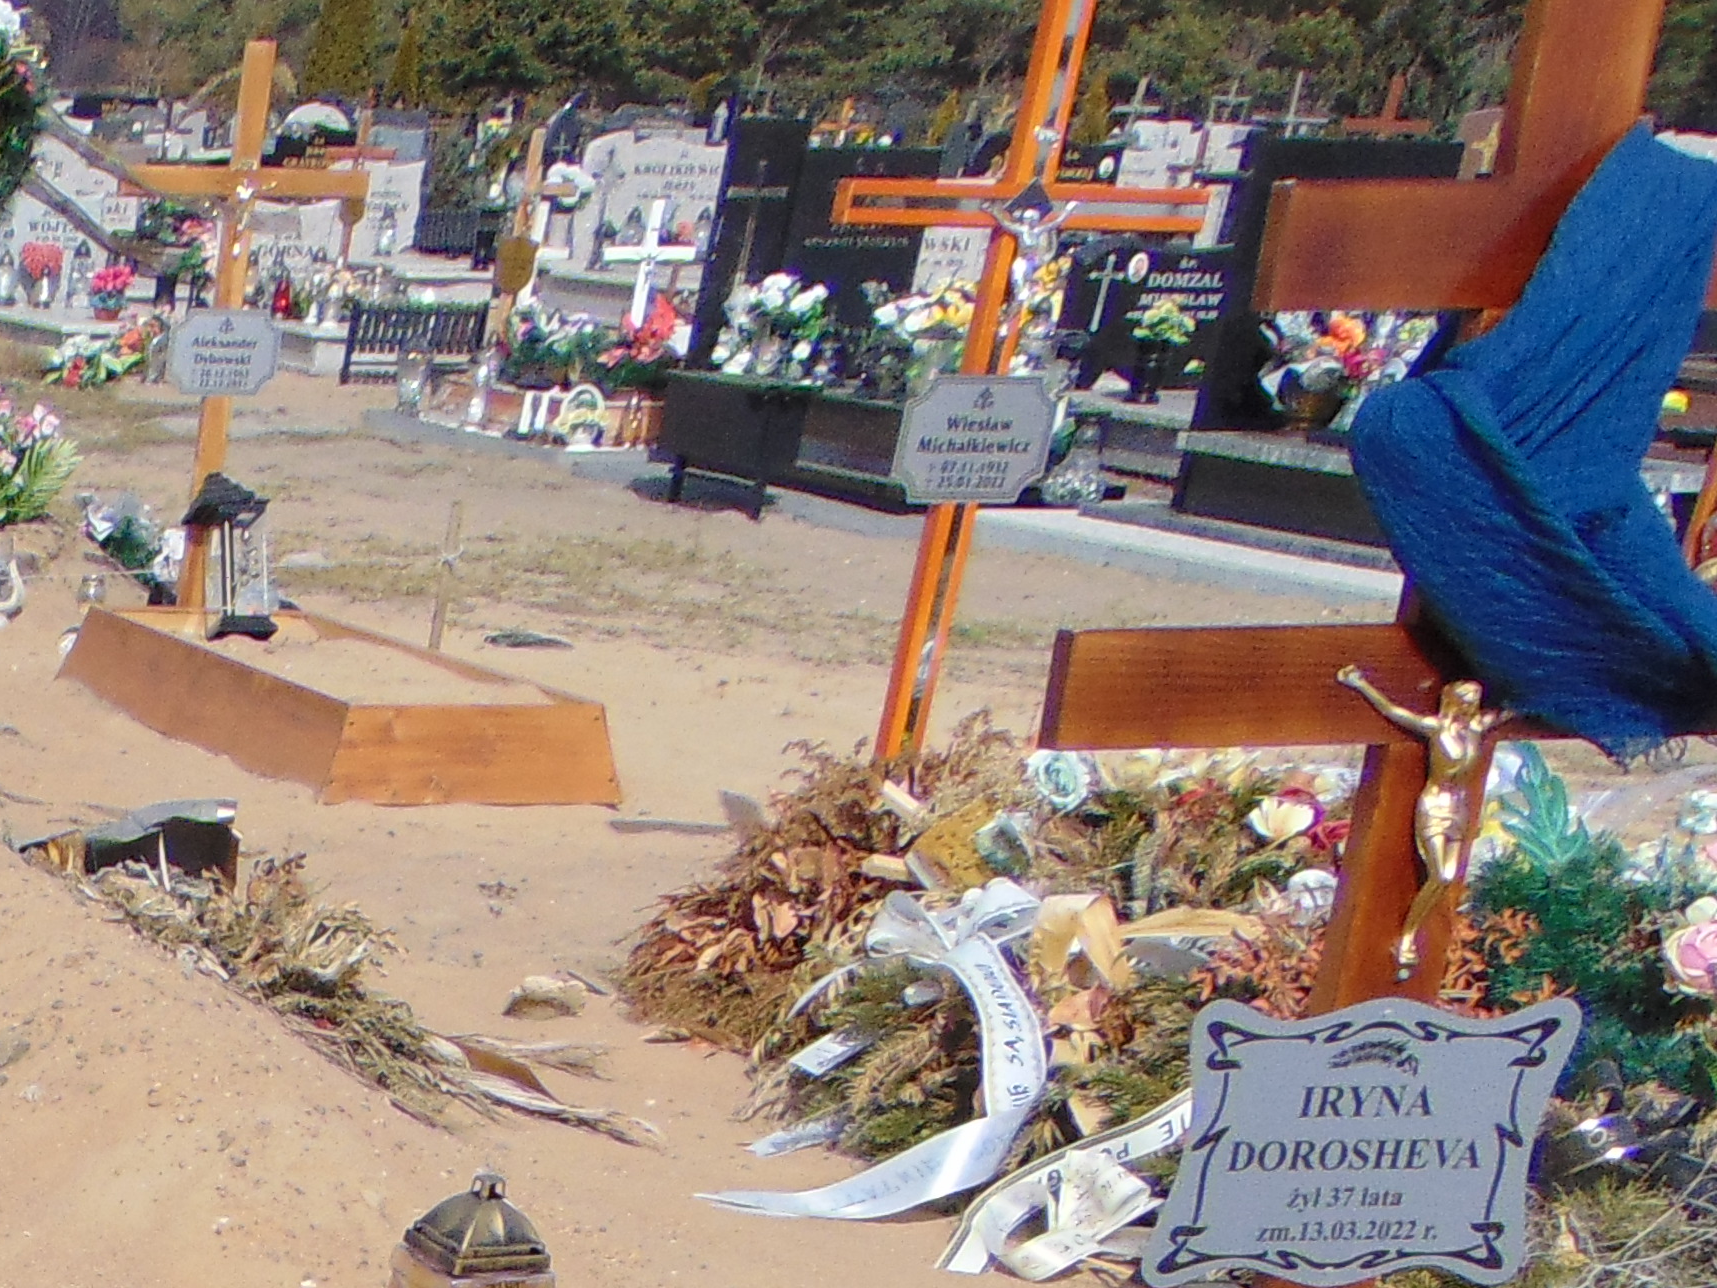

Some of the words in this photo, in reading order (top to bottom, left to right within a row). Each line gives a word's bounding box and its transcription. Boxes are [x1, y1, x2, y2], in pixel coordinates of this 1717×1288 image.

[1297, 1084, 1433, 1120] IRYNA
[1226, 1138, 1481, 1173] DOROSHEVA
[1326, 1187, 1355, 1209] 37
[1360, 1188, 1404, 1208] lata
